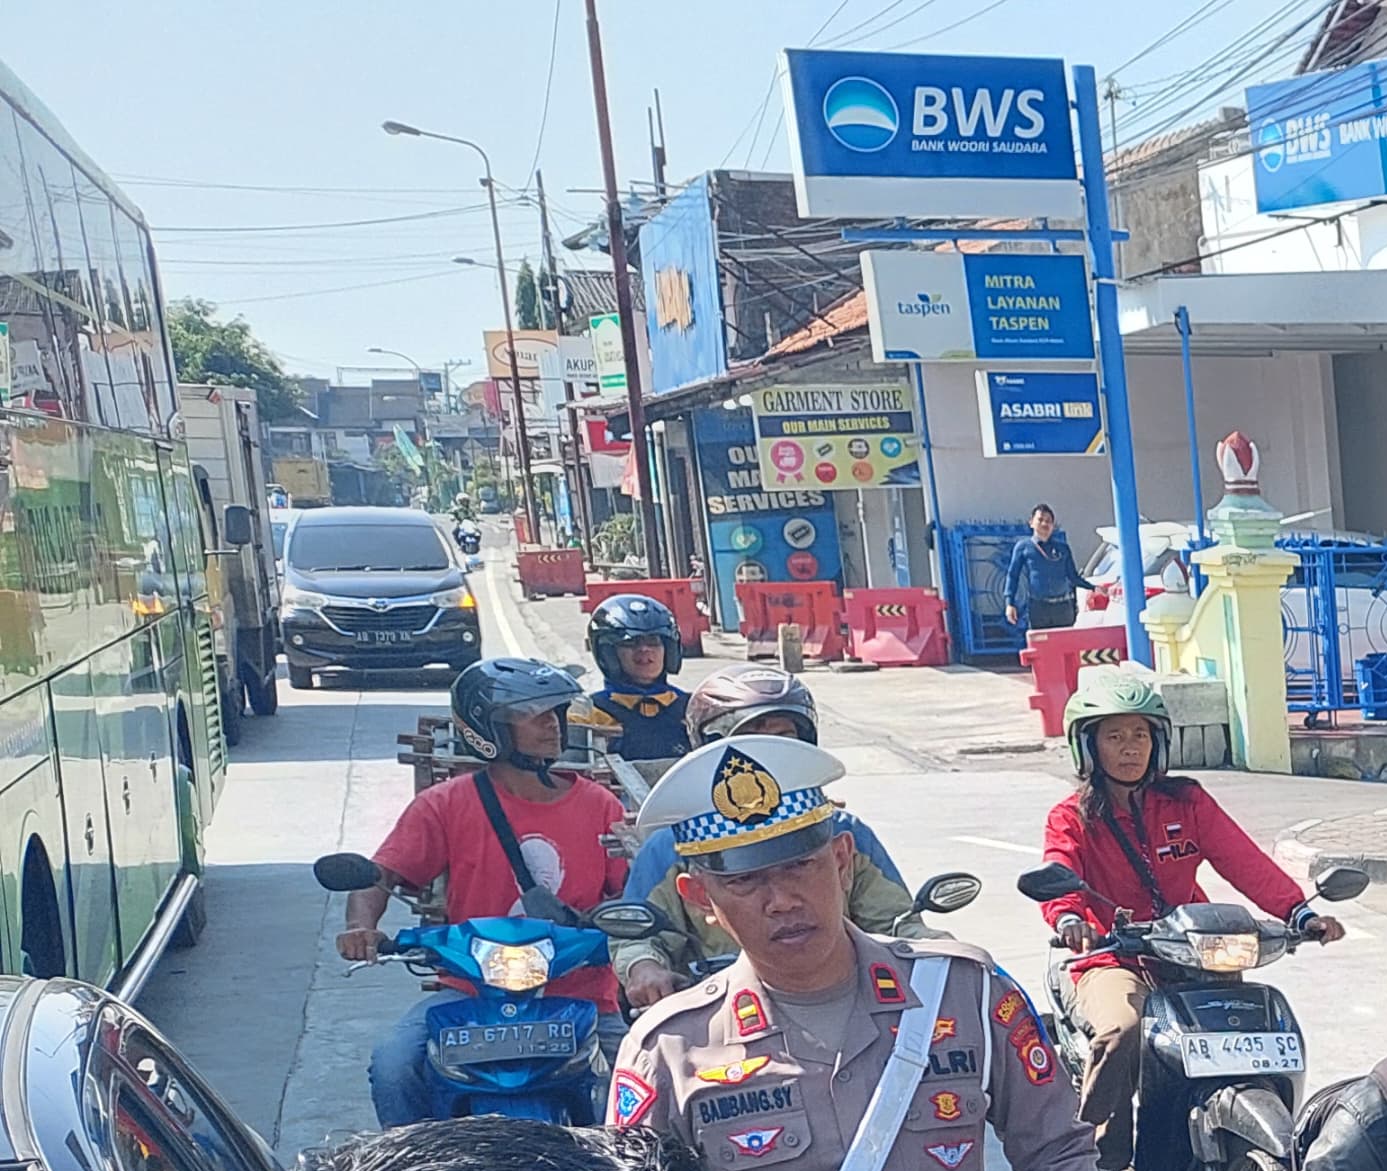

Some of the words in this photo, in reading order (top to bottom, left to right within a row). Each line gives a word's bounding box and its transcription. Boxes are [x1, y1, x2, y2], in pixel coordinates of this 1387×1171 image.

[911, 86, 1046, 139] BWS
[1339, 121, 1371, 144] BANK
[911, 140, 944, 151] BANK
[947, 141, 989, 152] WOORI
[992, 142, 1047, 154] SAUDARA
[984, 275, 1035, 288] MITRA
[897, 302, 951, 317] taspen
[987, 297, 1061, 310] LAYANAN
[989, 316, 1050, 331] TASPEN
[763, 391, 843, 412] GARMENT
[850, 390, 903, 411] STORE
[1000, 403, 1062, 418] ASABRI
[782, 420, 804, 434] OUR
[807, 419, 837, 432] MAIN
[838, 416, 891, 431] SERVICES
[707, 490, 826, 515] SERVICES
[1156, 839, 1200, 863] FILA
[446, 1030, 470, 1046] AB
[484, 1025, 534, 1042] 6717
[548, 1023, 572, 1038] RC
[1188, 1038, 1210, 1054] AB
[1222, 1036, 1264, 1053] 4435
[1276, 1036, 1297, 1052] SC
